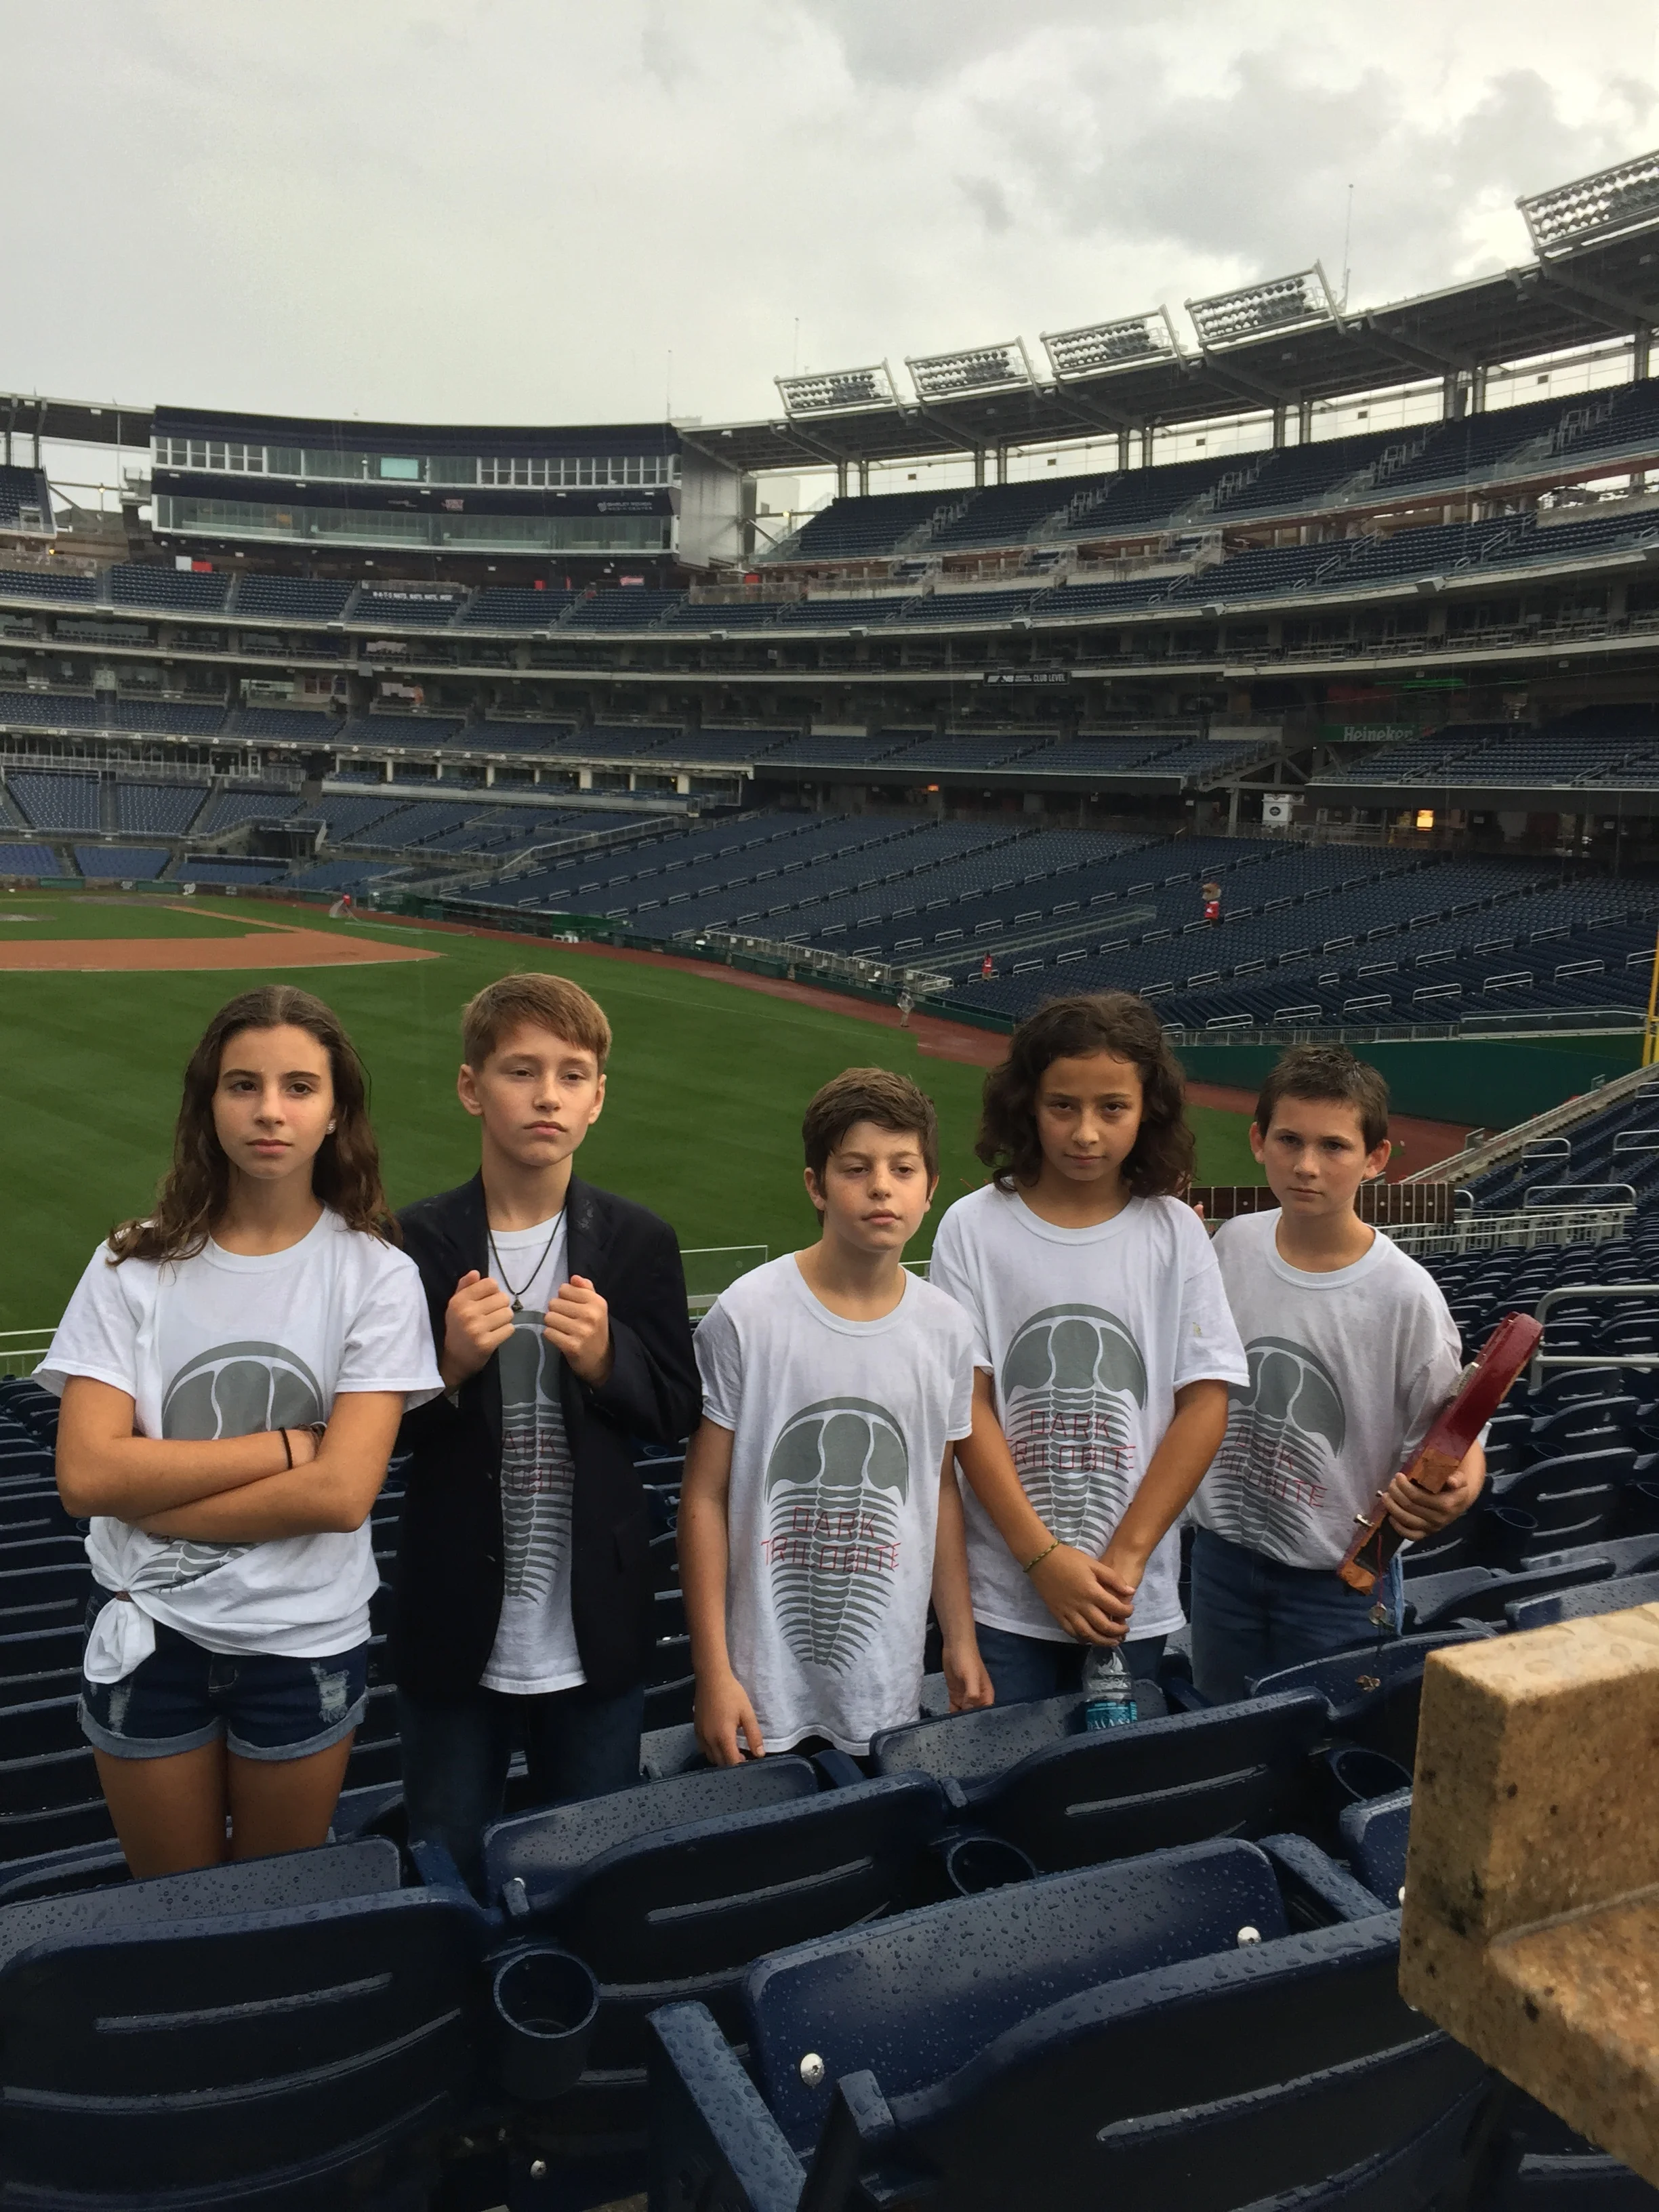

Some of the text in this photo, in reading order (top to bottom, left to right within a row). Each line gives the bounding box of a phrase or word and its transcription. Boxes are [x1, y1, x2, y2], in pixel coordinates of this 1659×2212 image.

[1048, 673, 1066, 682] LEVEL
[1030, 1410, 1112, 1439] DARK
[793, 1507, 878, 1539] DARK
[760, 1536, 901, 1573] TRILOBITE
